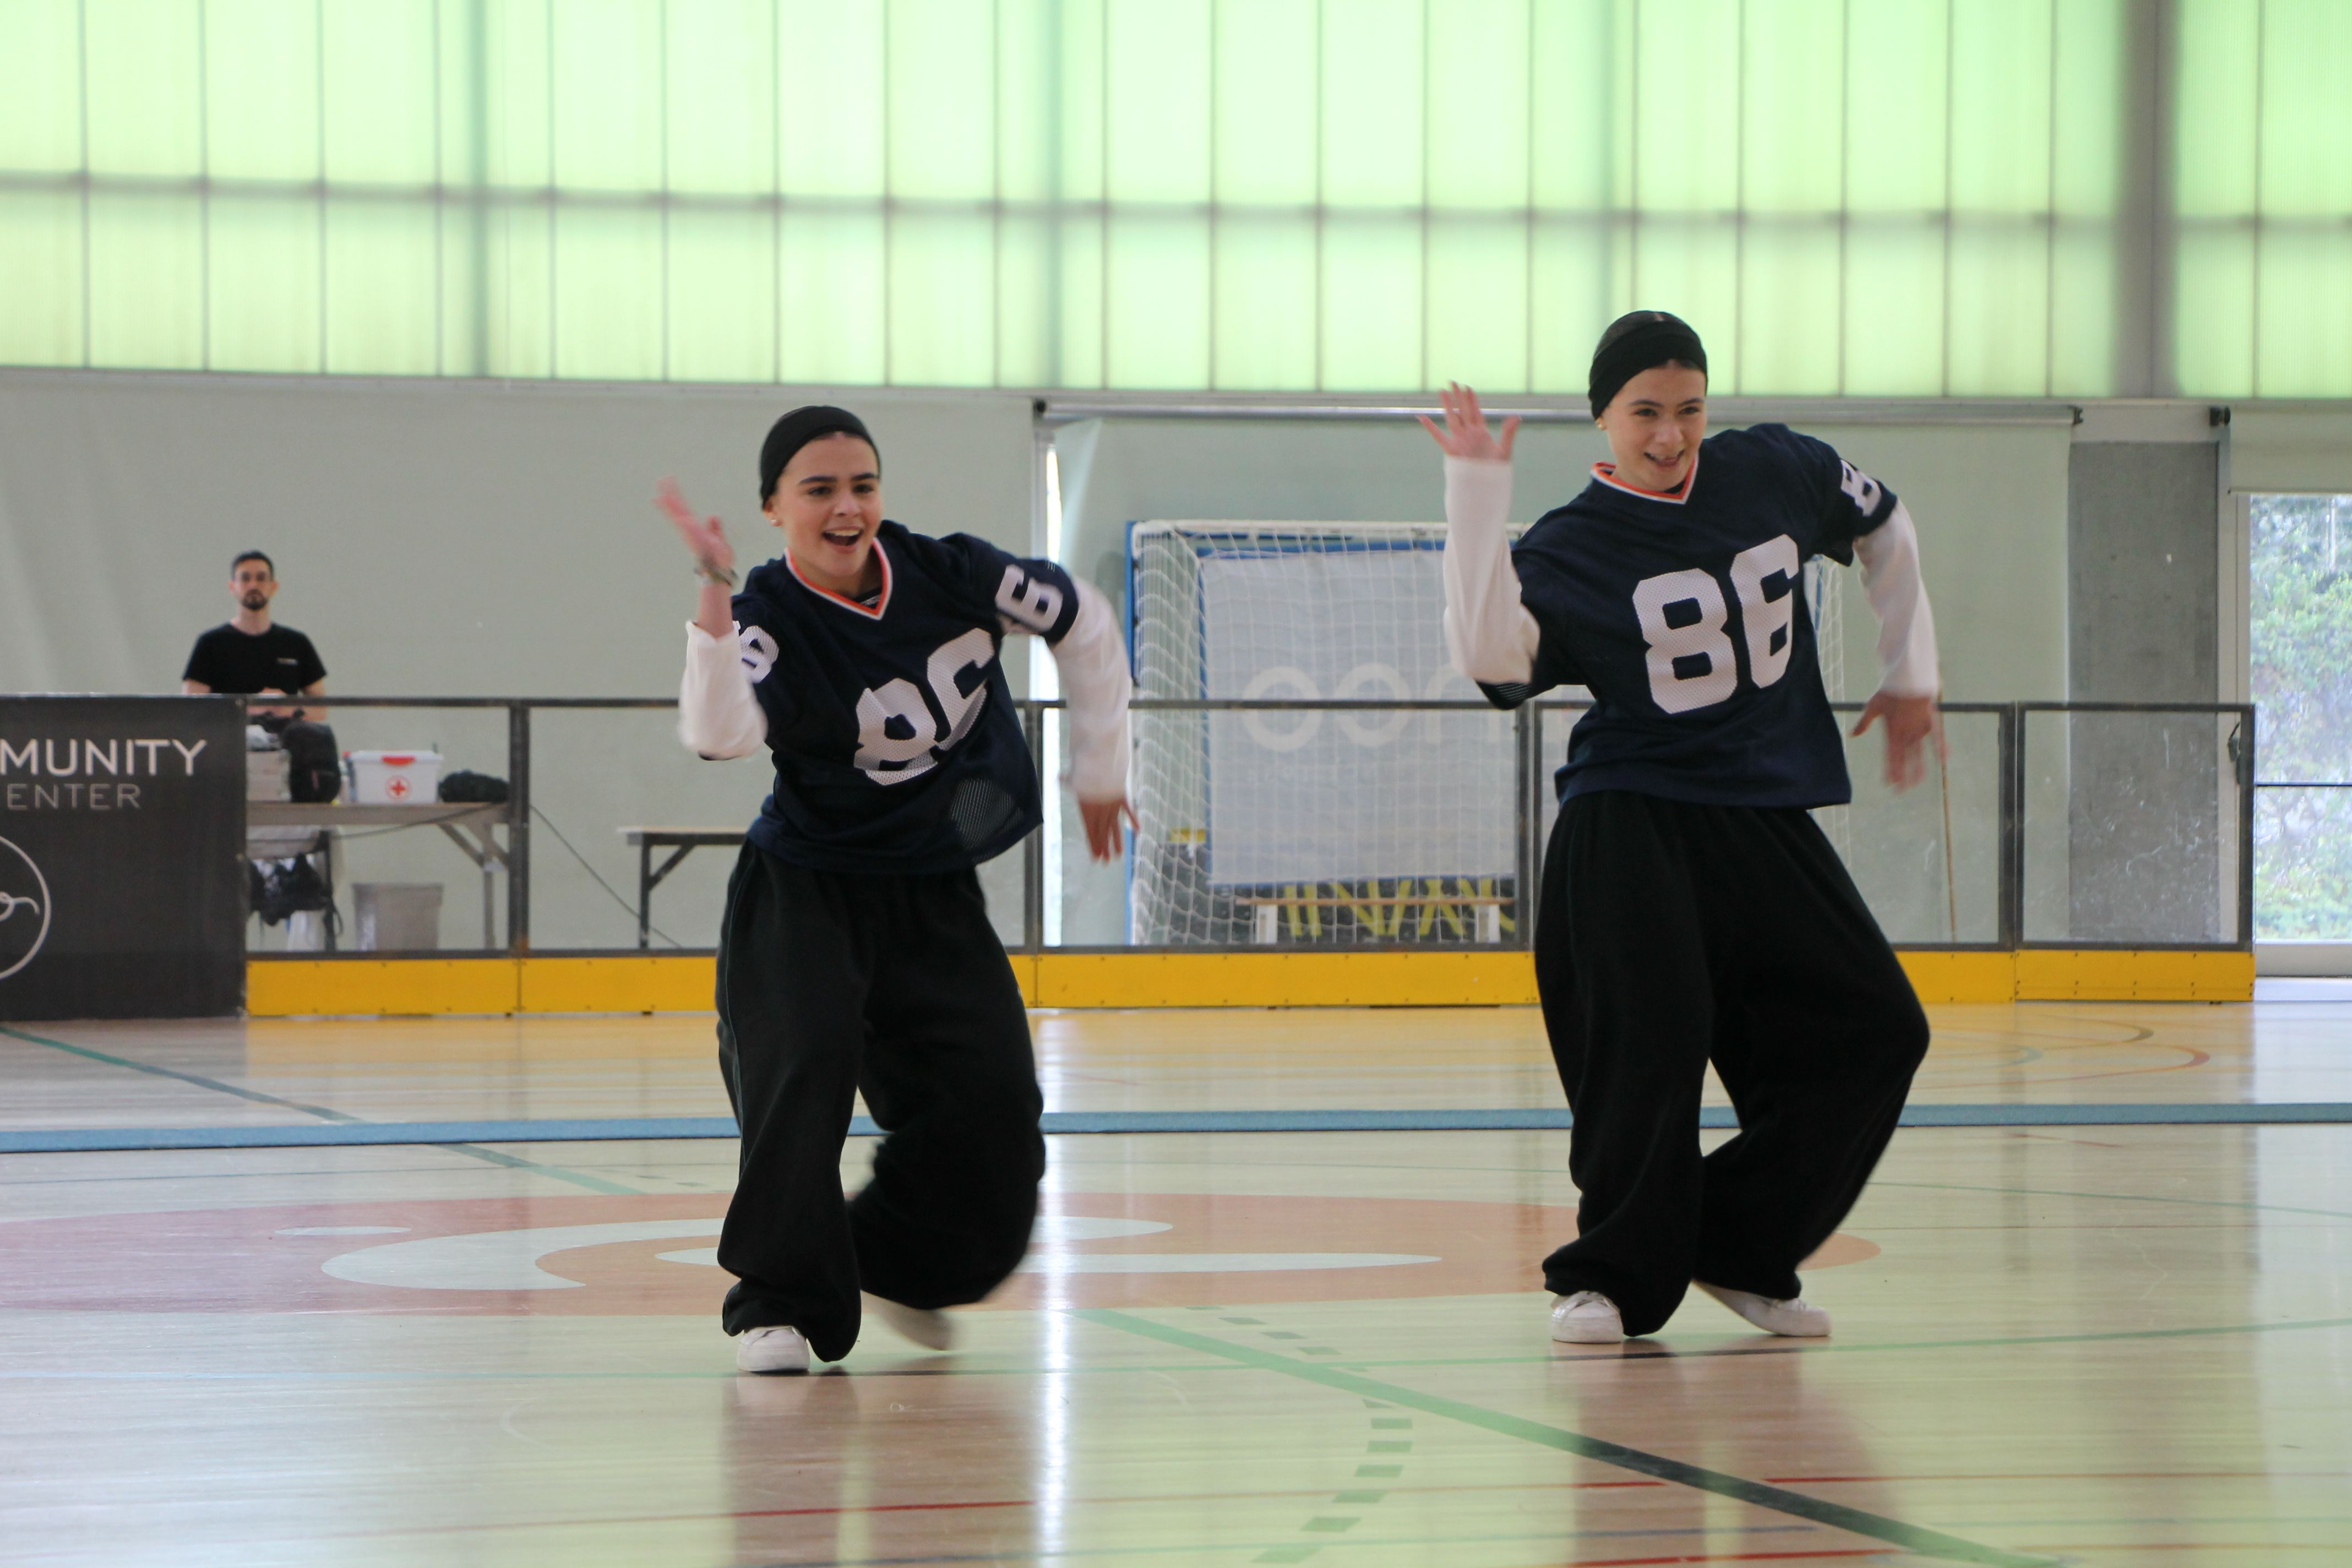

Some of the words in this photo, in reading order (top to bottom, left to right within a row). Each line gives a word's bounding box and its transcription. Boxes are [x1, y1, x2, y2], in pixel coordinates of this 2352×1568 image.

[1632, 533, 1799, 714] 86
[0, 738, 206, 776] MUNITY
[7, 783, 141, 810] ENTER
